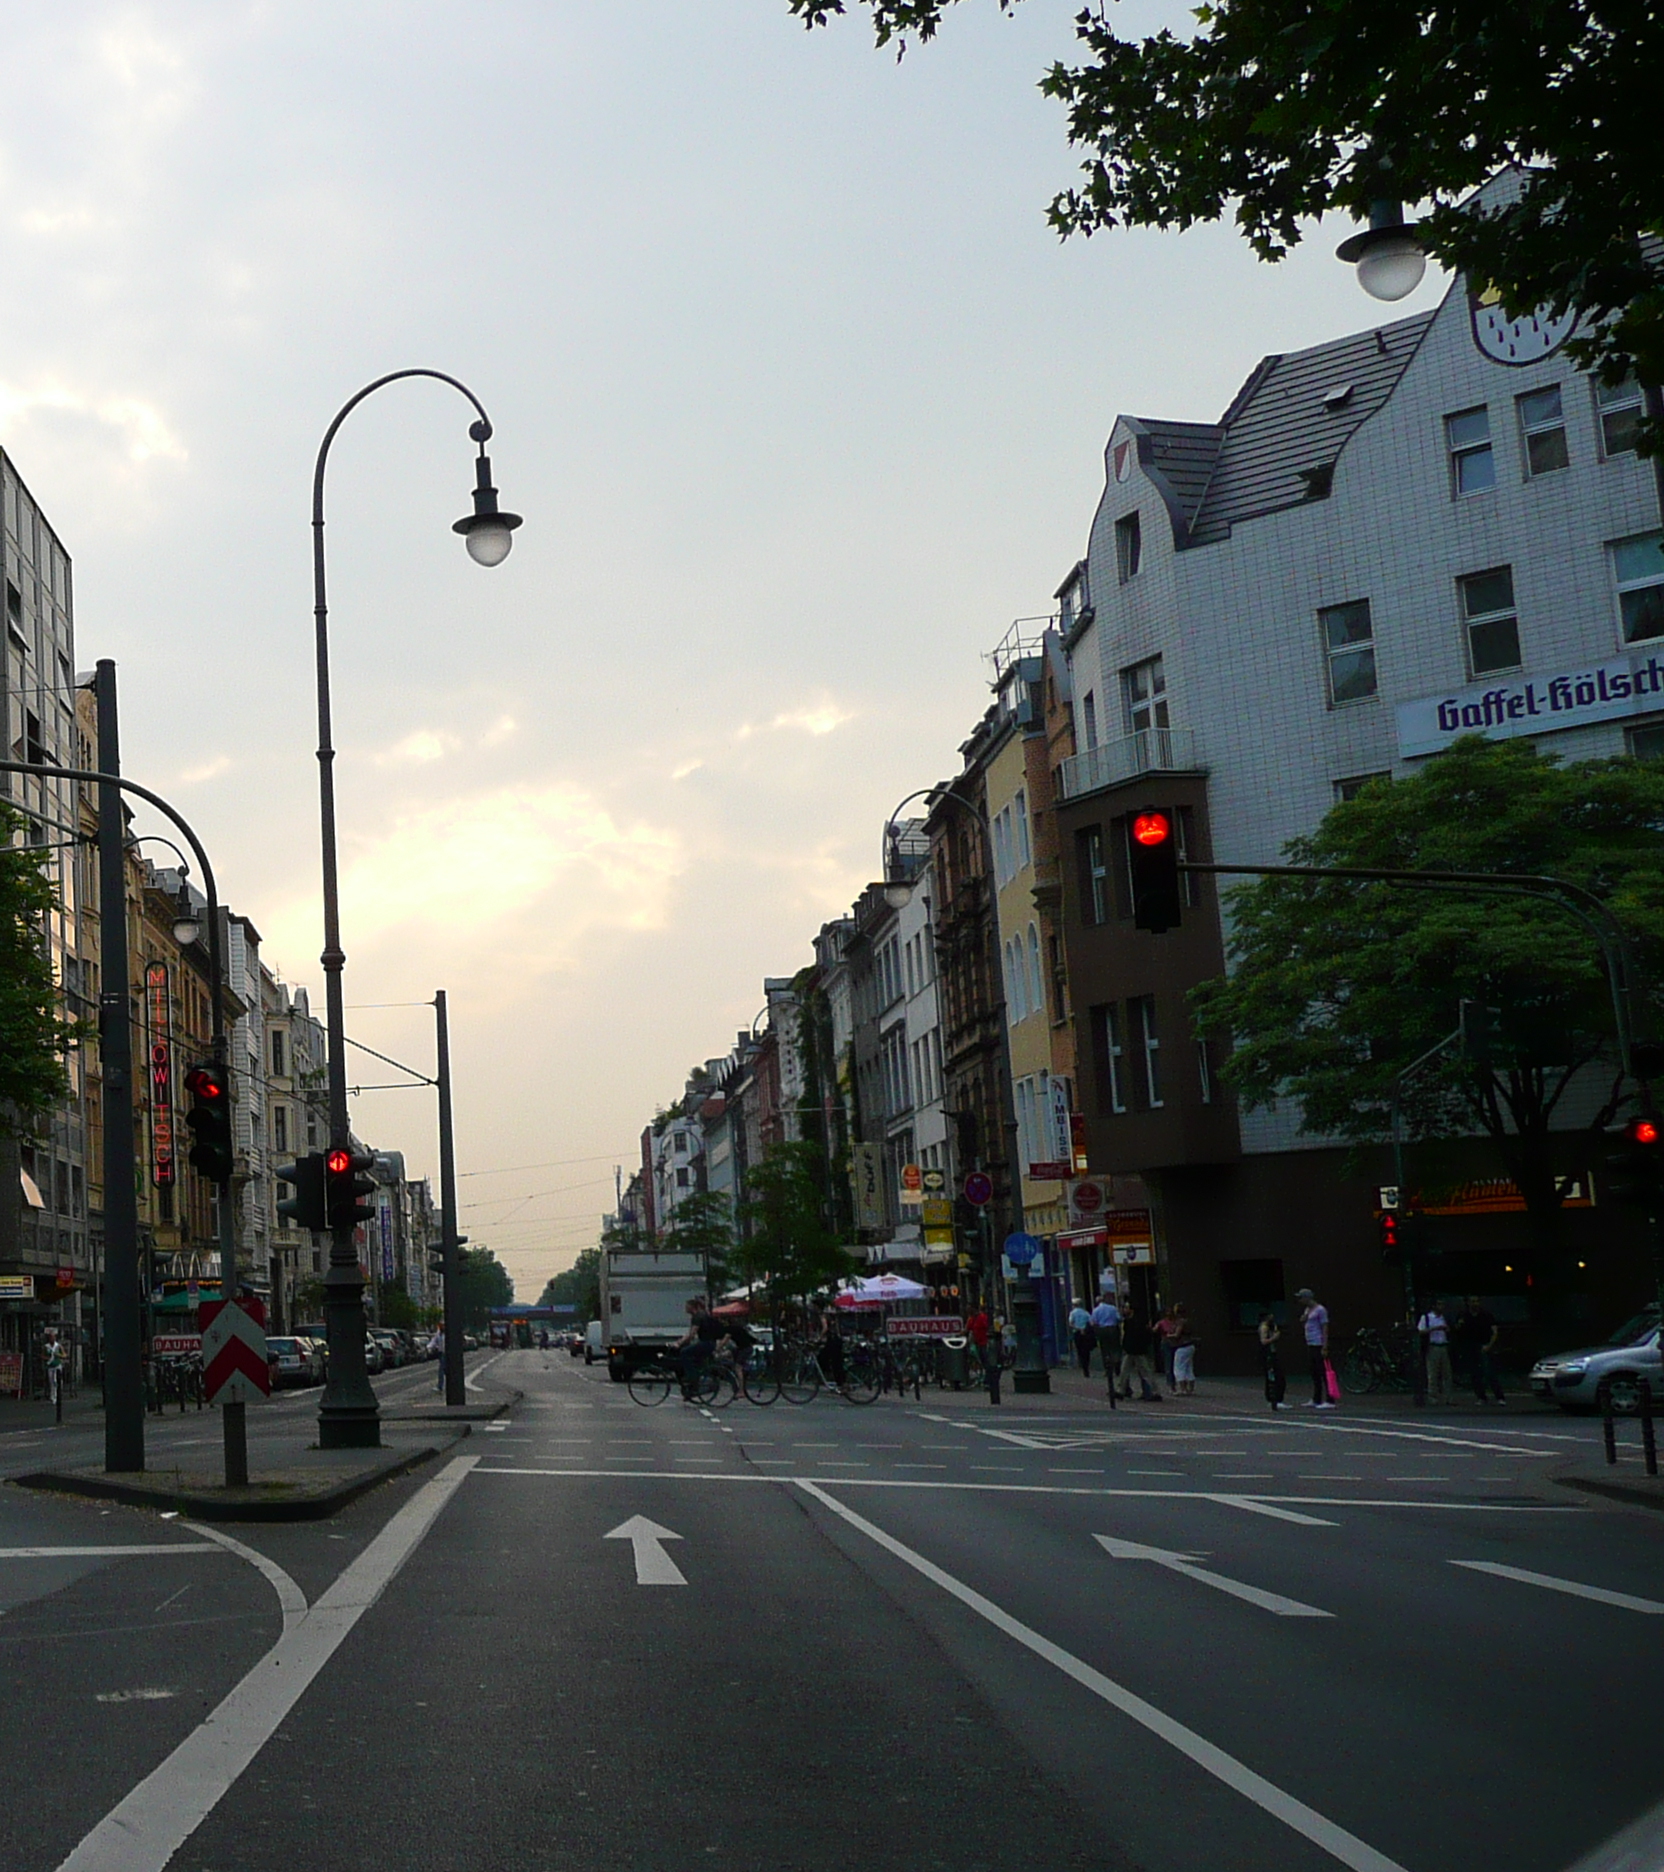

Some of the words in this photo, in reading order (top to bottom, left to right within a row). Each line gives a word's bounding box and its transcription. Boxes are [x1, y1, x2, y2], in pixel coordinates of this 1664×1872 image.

[148, 968, 172, 1183] MILLOWITSCH
[1054, 1094, 1069, 1157] IMBISS
[155, 1340, 201, 1351] BAUHA
[888, 1320, 961, 1333] BAUHAUS
